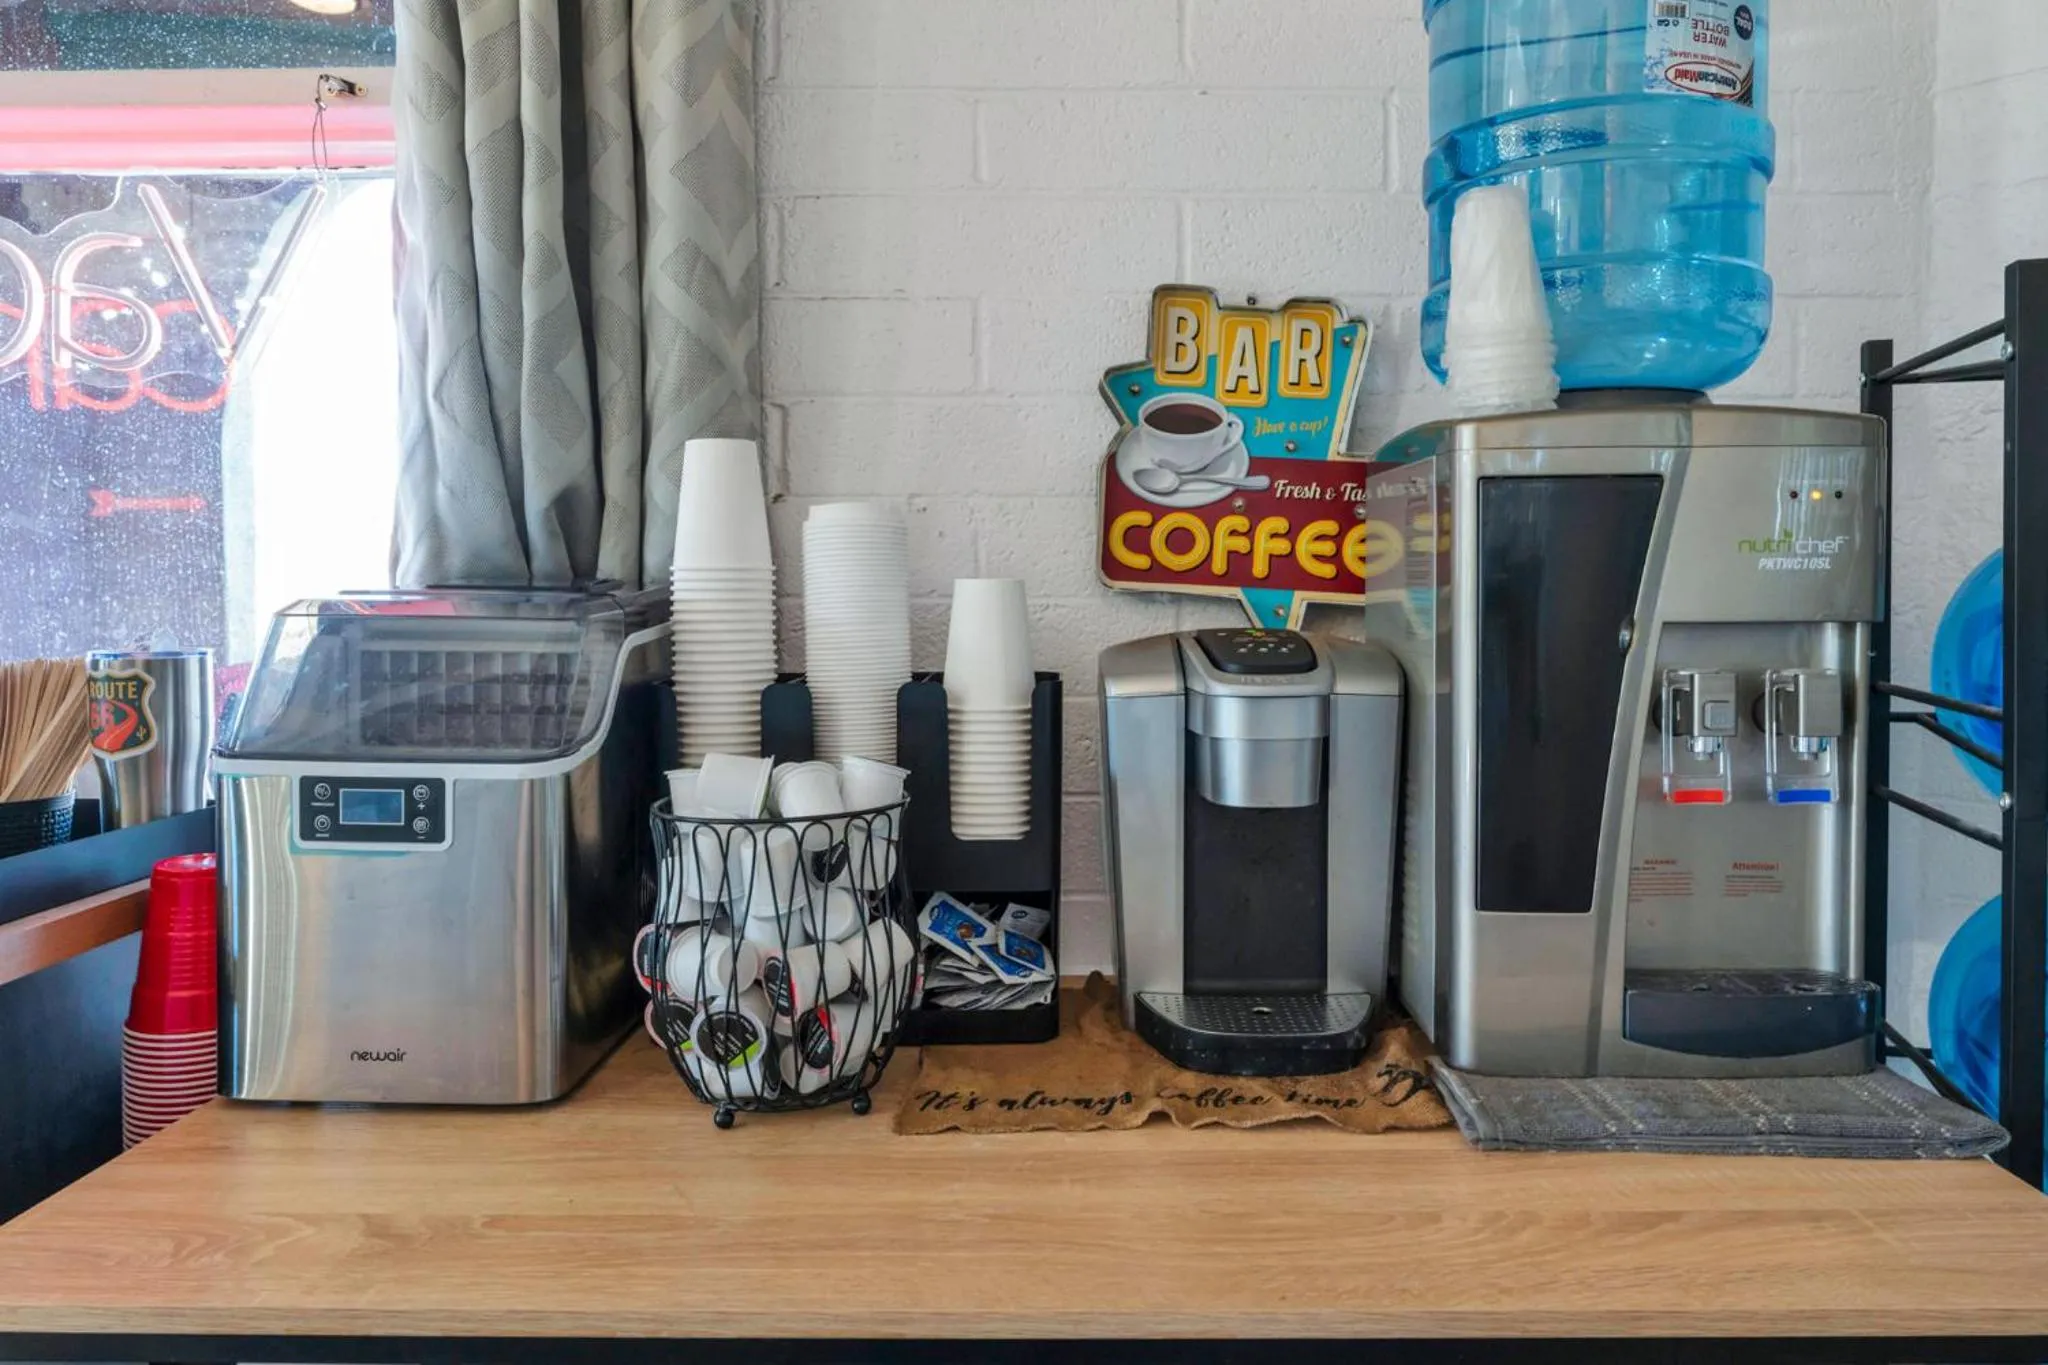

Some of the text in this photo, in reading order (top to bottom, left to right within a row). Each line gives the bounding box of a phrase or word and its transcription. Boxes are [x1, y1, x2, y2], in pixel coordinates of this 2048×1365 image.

[1691, 18, 1730, 37] BOTTLE
[1692, 31, 1727, 48] WATER
[1674, 68, 1738, 91] AmericanMaid
[1164, 306, 1324, 396] BAR
[1252, 415, 1329, 440] Have a cup!
[1274, 479, 1321, 500] Fresh
[1325, 484, 1336, 500] &
[90, 681, 137, 699] ROUTE
[90, 703, 114, 729] 66
[350, 1048, 407, 1063] newair
[914, 1090, 988, 1112] It's
[996, 1089, 1135, 1117] always
[1284, 1089, 1366, 1110] time
